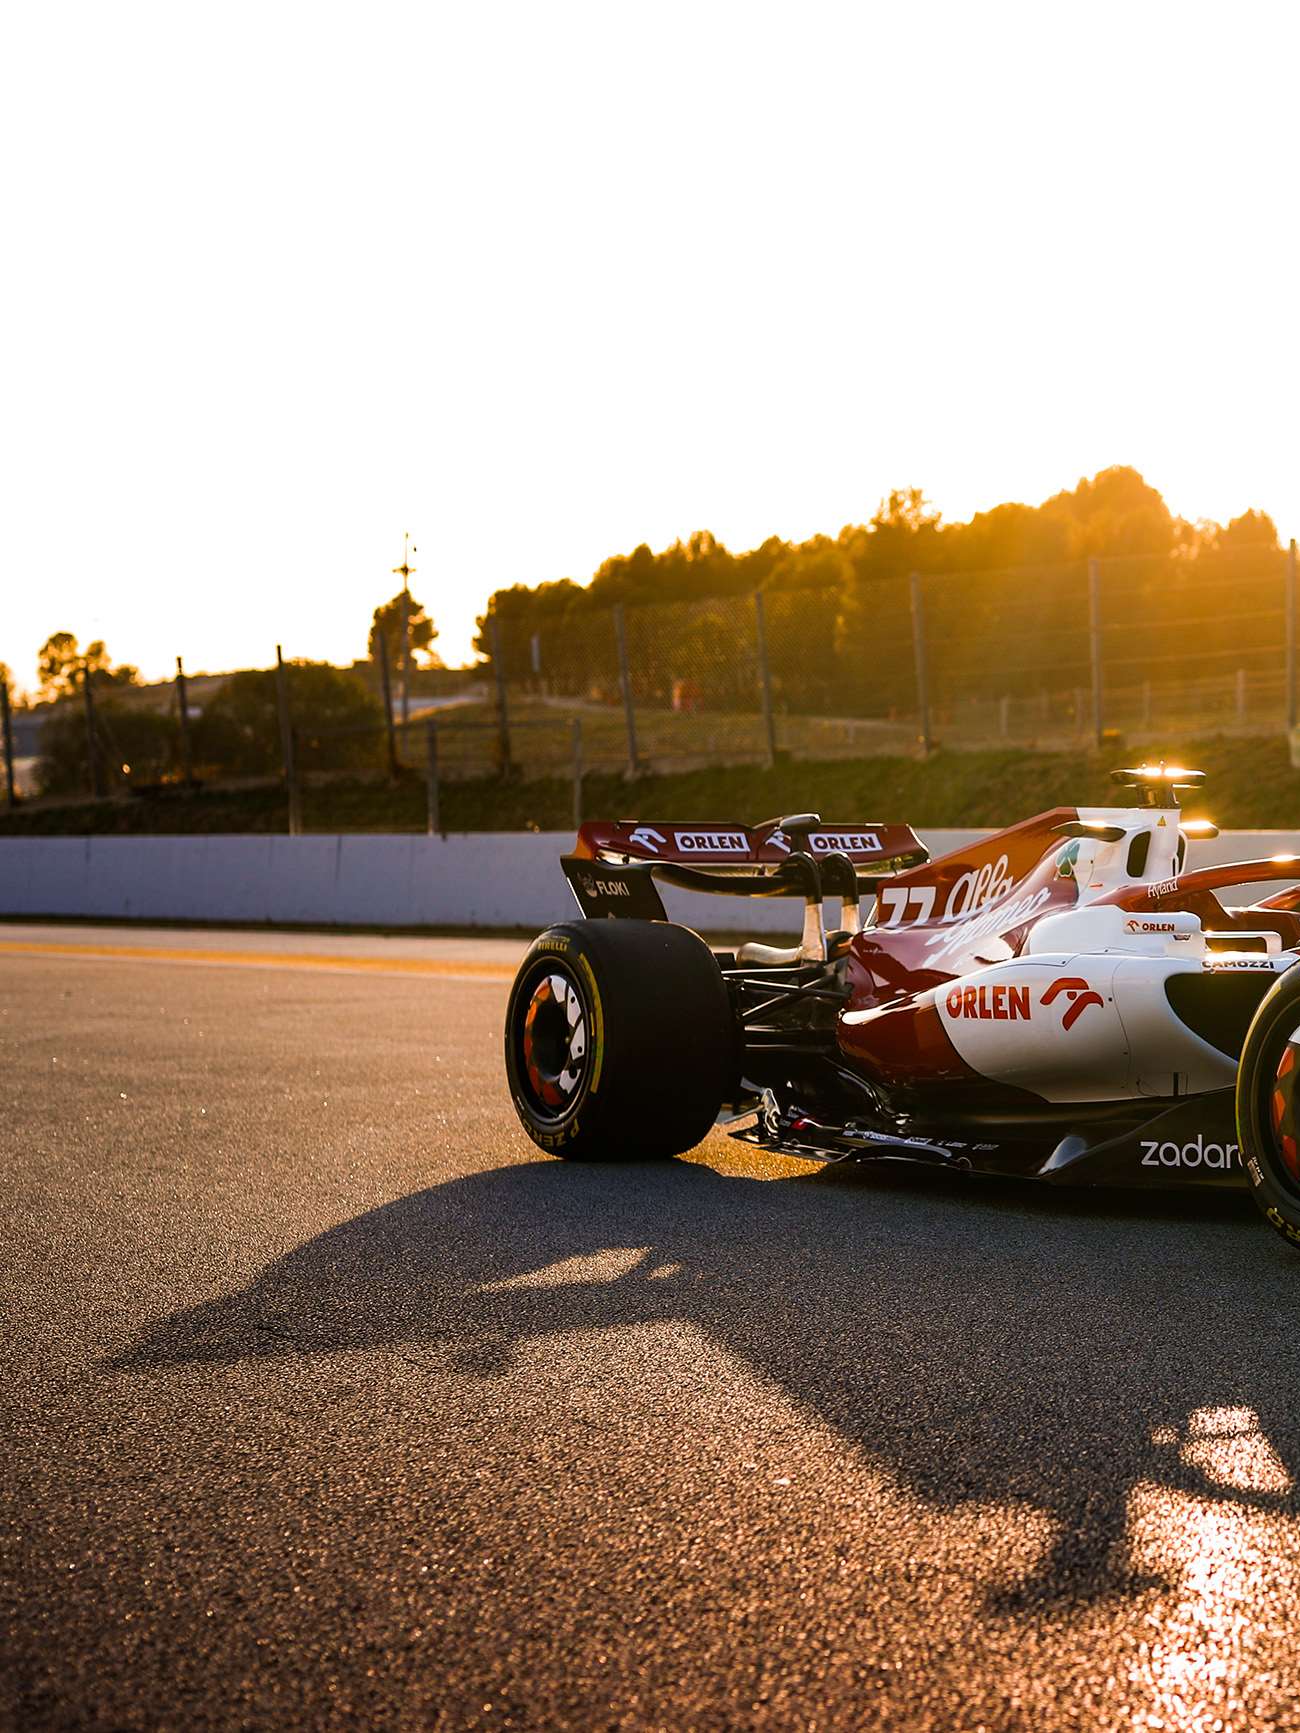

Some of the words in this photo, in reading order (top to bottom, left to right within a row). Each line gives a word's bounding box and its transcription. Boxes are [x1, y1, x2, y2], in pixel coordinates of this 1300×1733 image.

[680, 834, 745, 850] ORLEN
[813, 835, 876, 850] ORLEN
[596, 879, 630, 897] FLOKI
[1147, 877, 1179, 900] Hyland
[882, 886, 937, 928] 77
[1142, 922, 1176, 932] ORLEN
[1202, 959, 1275, 969] CAMOZZI
[946, 985, 1032, 1021] ORLEN
[1140, 1134, 1243, 1169] zadar
